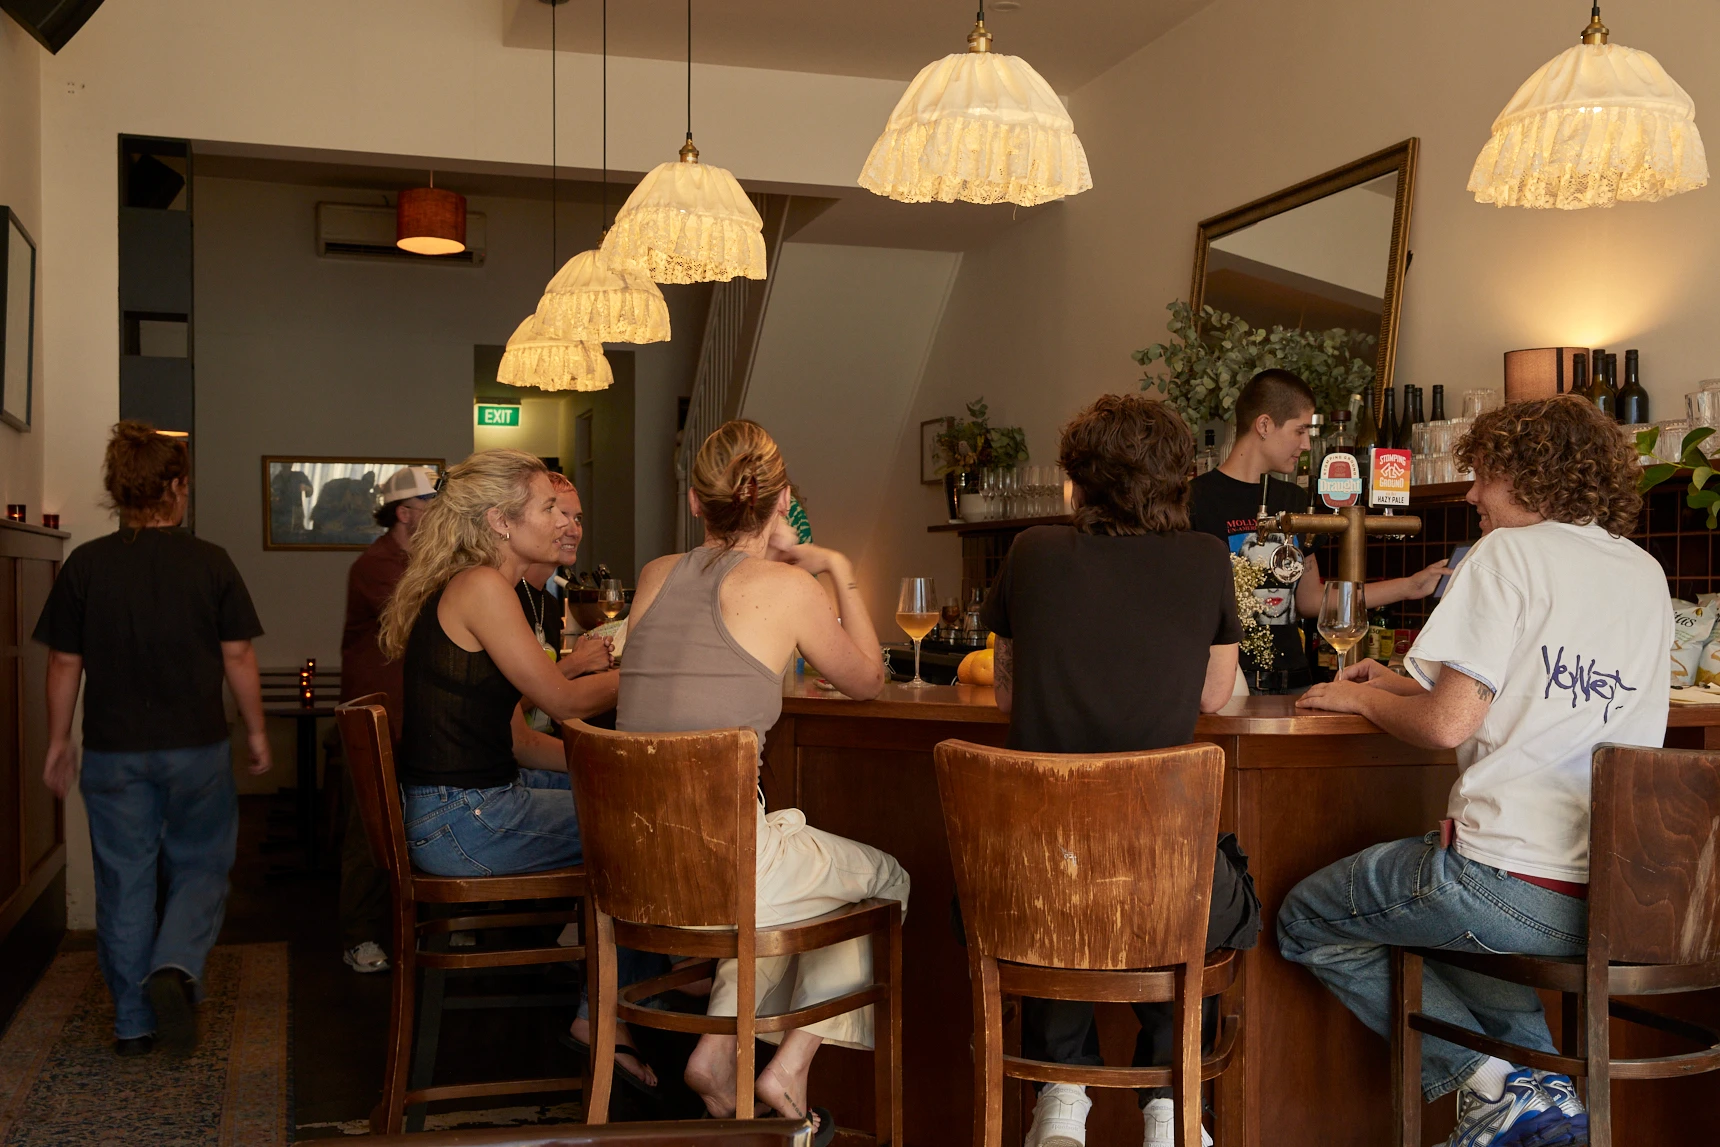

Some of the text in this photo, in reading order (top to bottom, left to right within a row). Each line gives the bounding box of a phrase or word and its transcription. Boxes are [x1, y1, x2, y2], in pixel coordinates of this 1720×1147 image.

[485, 409, 513, 424] EXIT
[1323, 455, 1357, 476] STOMPING GROUND
[1379, 454, 1406, 466] STOMPING
[1319, 479, 1361, 493] Draught
[1379, 477, 1404, 489] GROUND
[1377, 495, 1405, 504] HAZY PALE
[1226, 519, 1258, 527] MOLLY
